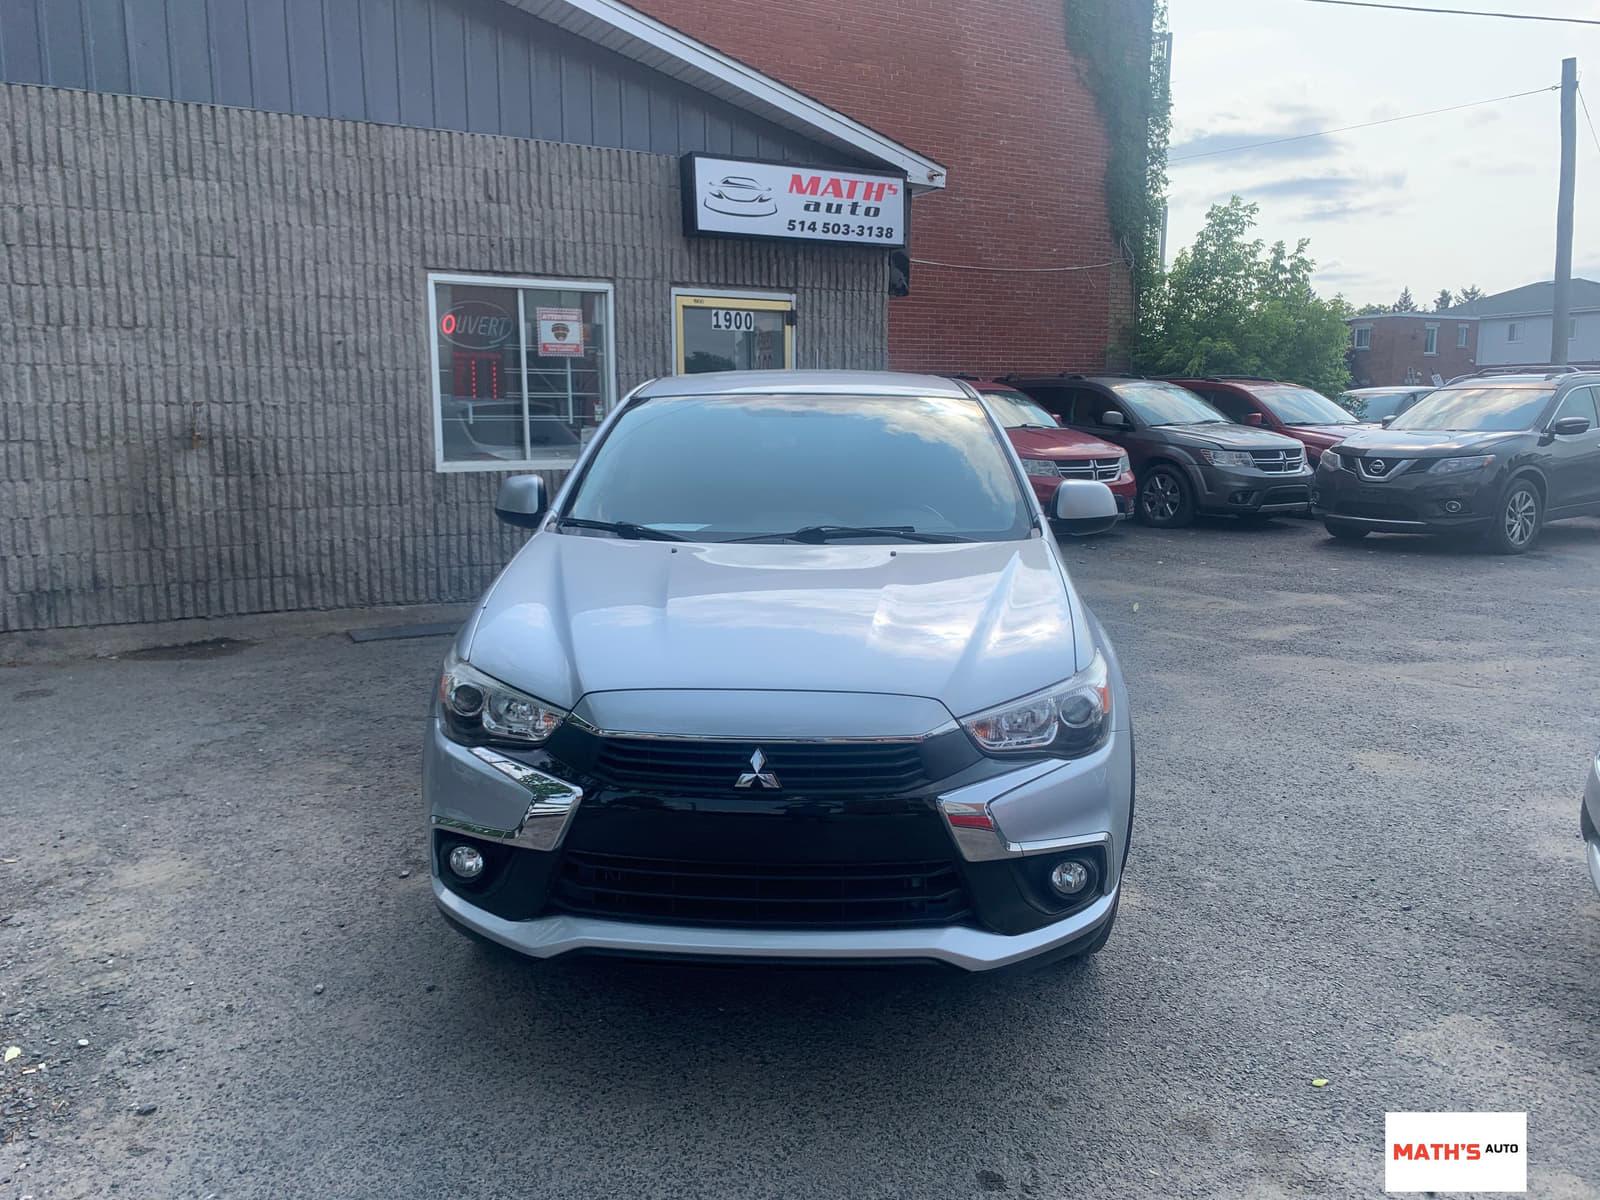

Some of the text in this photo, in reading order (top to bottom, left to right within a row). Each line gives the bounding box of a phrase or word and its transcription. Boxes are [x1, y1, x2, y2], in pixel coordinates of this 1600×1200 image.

[803, 200, 881, 218] auto
[787, 219, 894, 239] 514 503-3138
[441, 313, 509, 337] OUVERT
[713, 311, 753, 330] 1900
